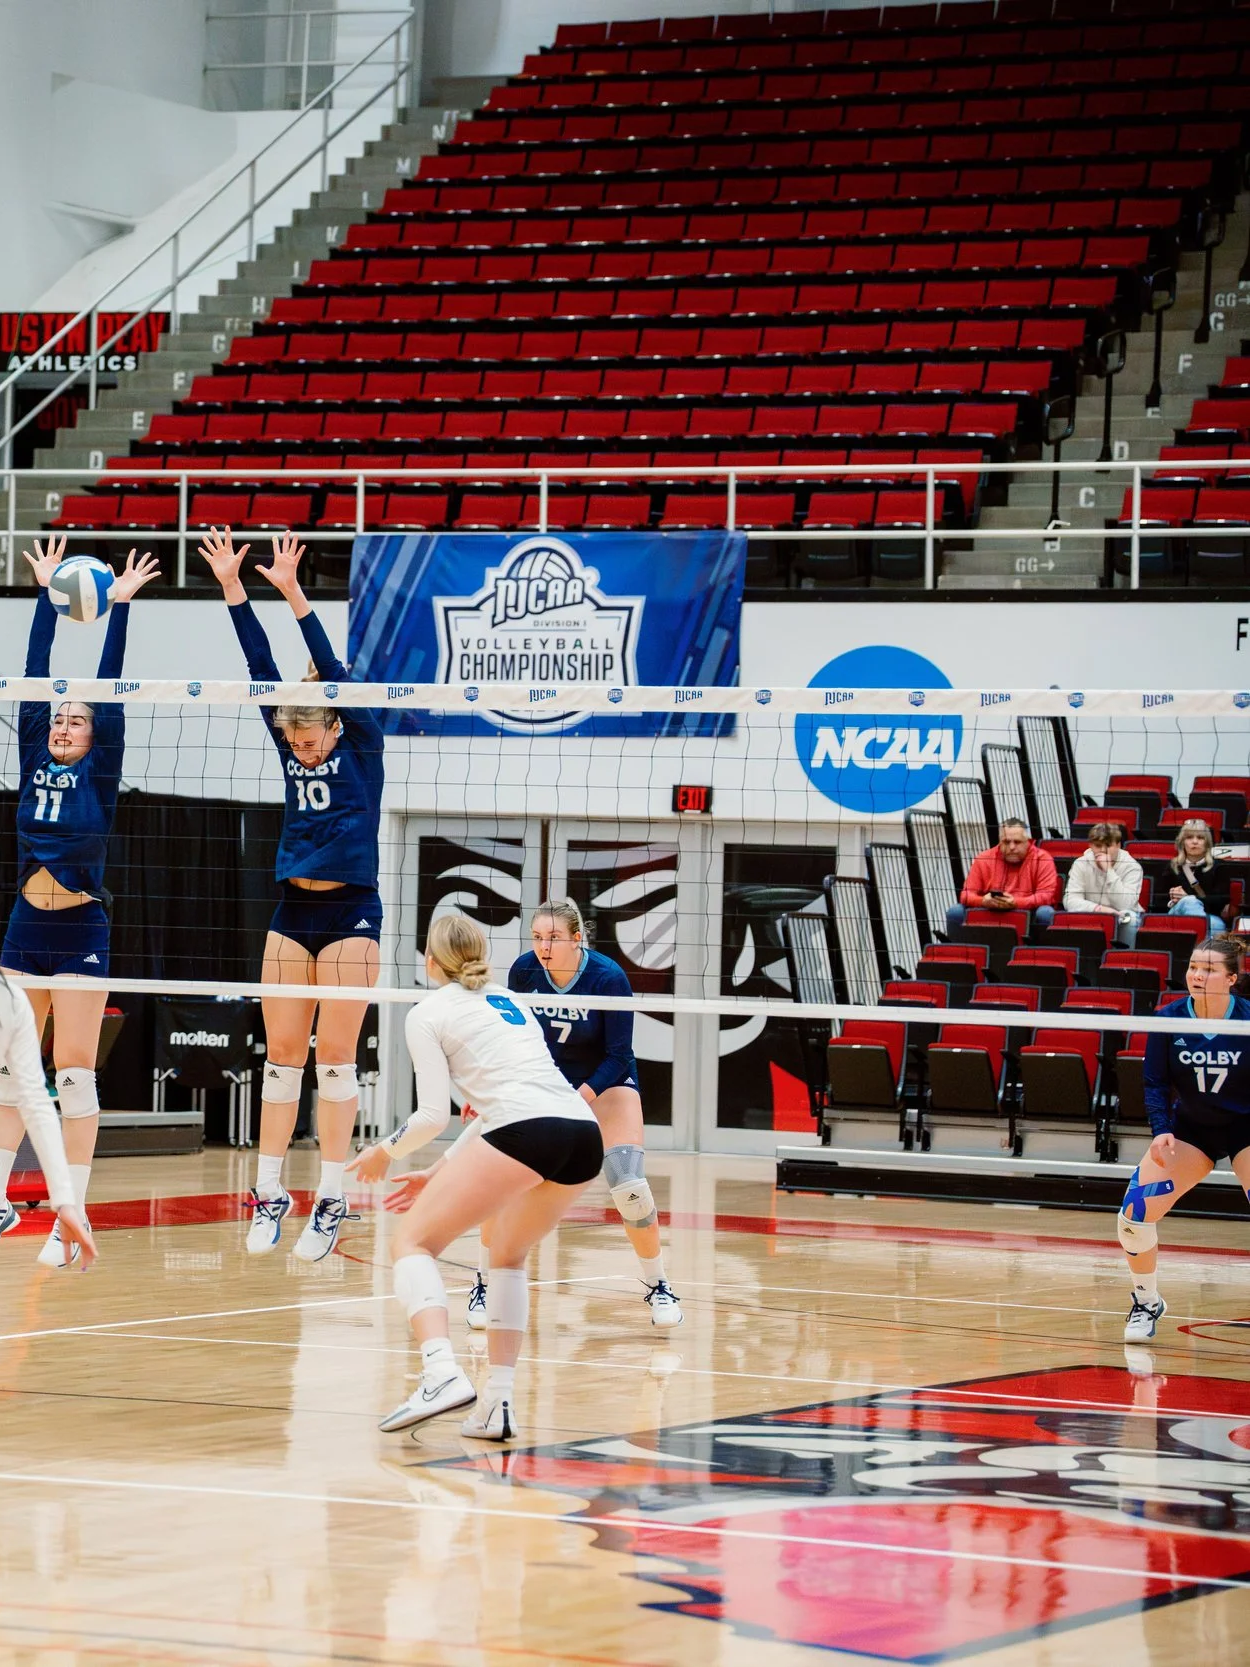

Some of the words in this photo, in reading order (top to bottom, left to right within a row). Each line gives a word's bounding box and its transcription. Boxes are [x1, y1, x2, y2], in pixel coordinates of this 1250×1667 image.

[252, 297, 265, 314] H
[1209, 312, 1224, 331] G
[212, 334, 226, 353] G
[1178, 354, 1193, 374] F
[173, 371, 185, 391] F
[132, 411, 145, 430] E
[89, 451, 103, 470] D
[1113, 441, 1130, 461] D
[46, 492, 60, 511] C
[1079, 487, 1096, 508] C
[1015, 558, 1039, 573] GG
[493, 577, 584, 627] NJCAA
[533, 620, 581, 628] DIVISION
[460, 638, 615, 650] VOLLEYBALL
[460, 653, 615, 681] CHAMPIONSHIP
[114, 682, 140, 695] NJCAA
[249, 684, 275, 697] NJCAA
[387, 687, 415, 699] NJCAA
[530, 689, 557, 702] NJCAA
[675, 690, 703, 703] NJCAA
[825, 692, 854, 705] NJCAA
[981, 692, 1011, 707] NJCAA
[1142, 694, 1174, 708] NJCAA
[811, 727, 956, 771] NCAA
[33, 769, 78, 788] OLBY
[34, 788, 63, 822] 11
[295, 780, 331, 811] 10
[676, 787, 707, 812] EXIT
[486, 995, 526, 1025] 9
[170, 1031, 228, 1047] molten
[550, 1020, 572, 1044] 7
[1178, 1050, 1242, 1066] COLBY
[1193, 1066, 1229, 1094] 17
